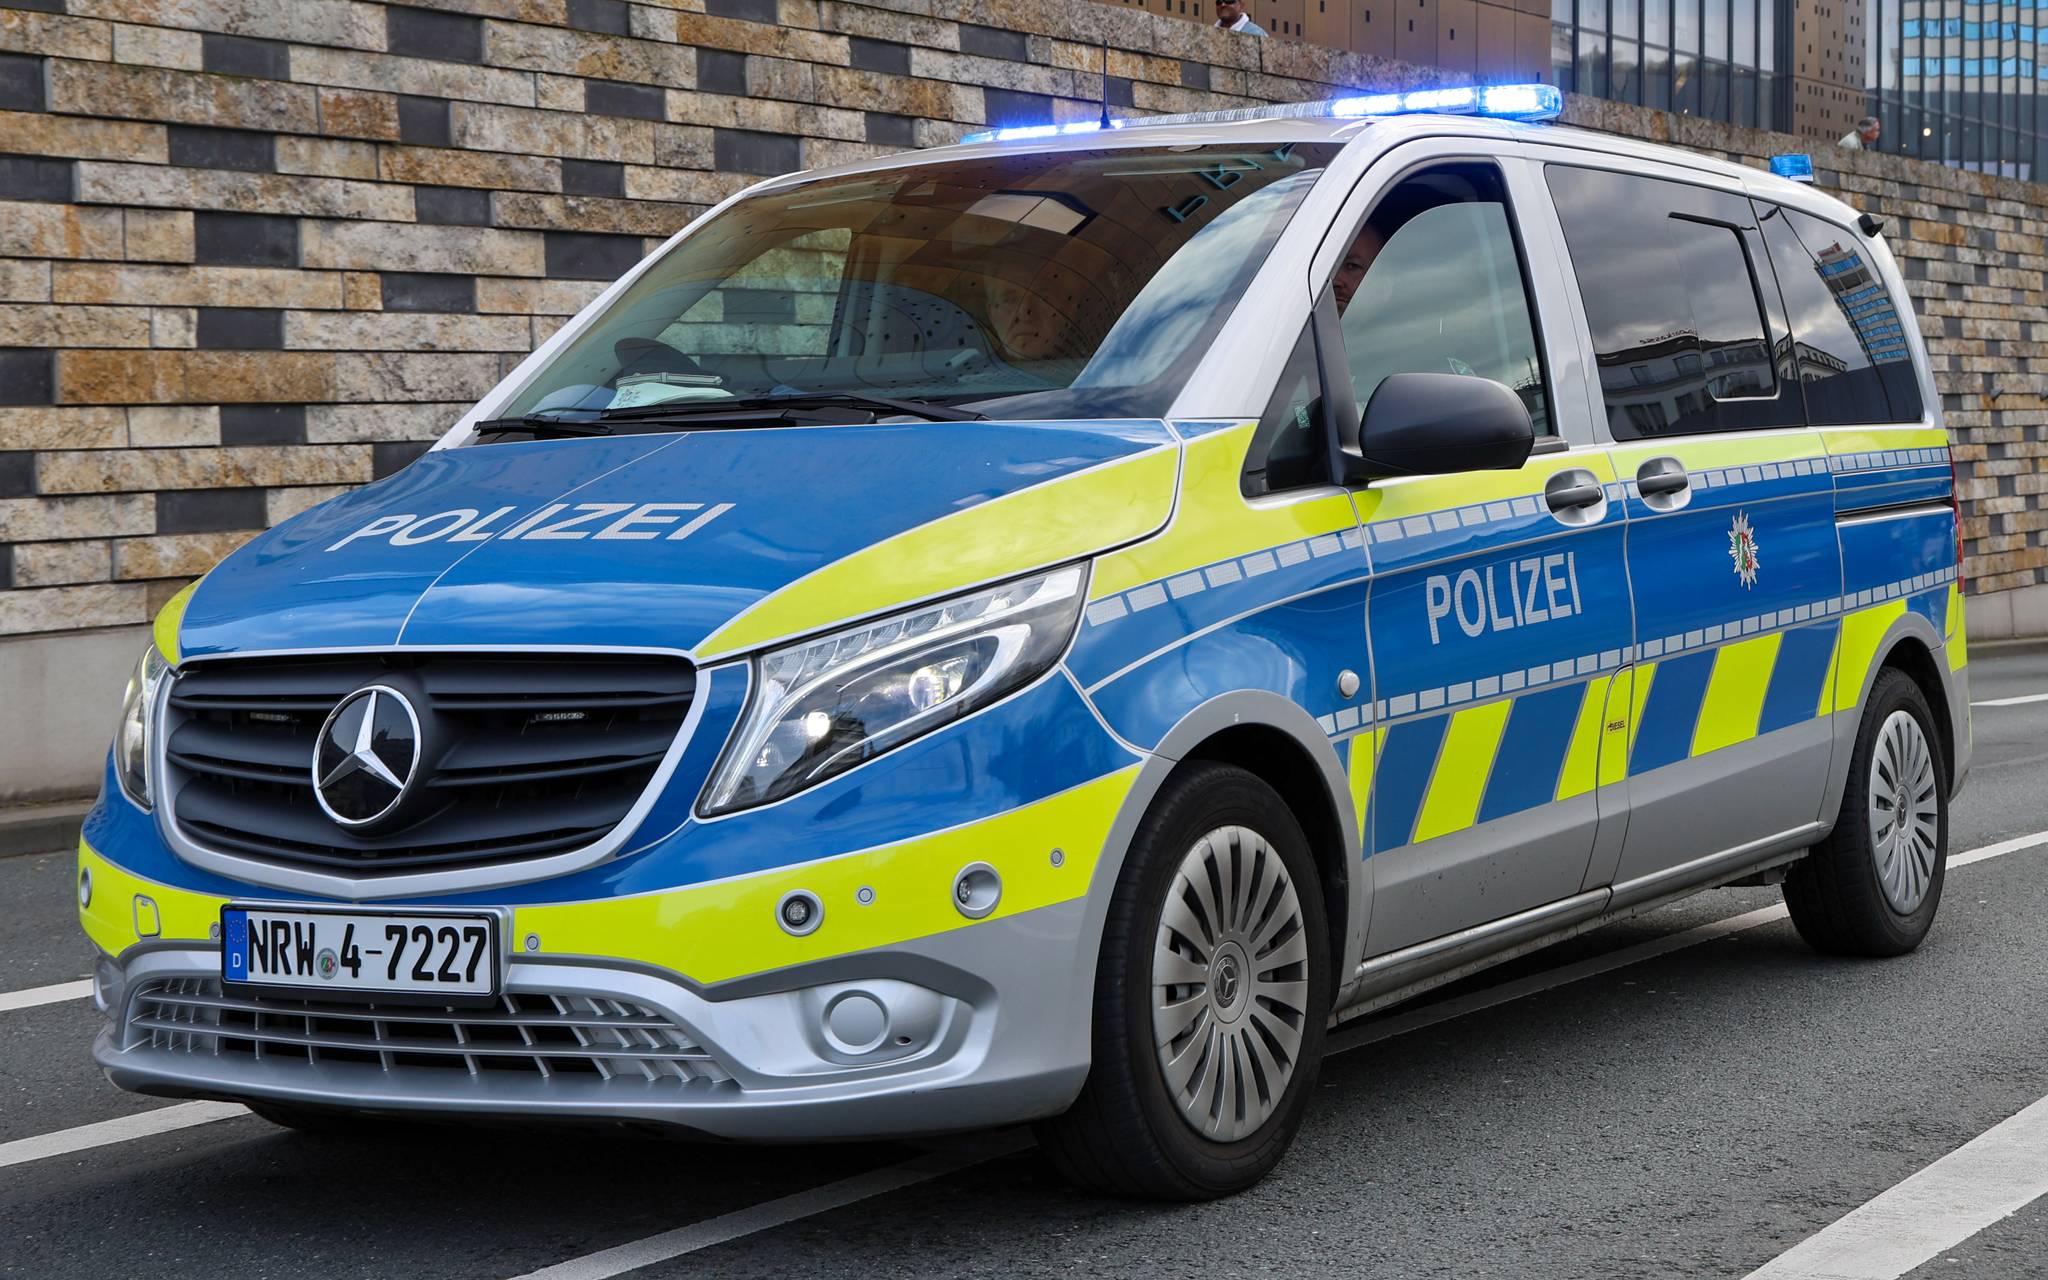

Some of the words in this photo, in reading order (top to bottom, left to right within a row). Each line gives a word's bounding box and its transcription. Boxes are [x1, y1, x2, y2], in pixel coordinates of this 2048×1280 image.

[324, 503, 737, 552] POLIZEI
[1426, 551, 1582, 645] POLIZEI
[232, 953, 242, 968] D
[248, 919, 316, 976] NRW
[340, 923, 487, 982] 4-7227
